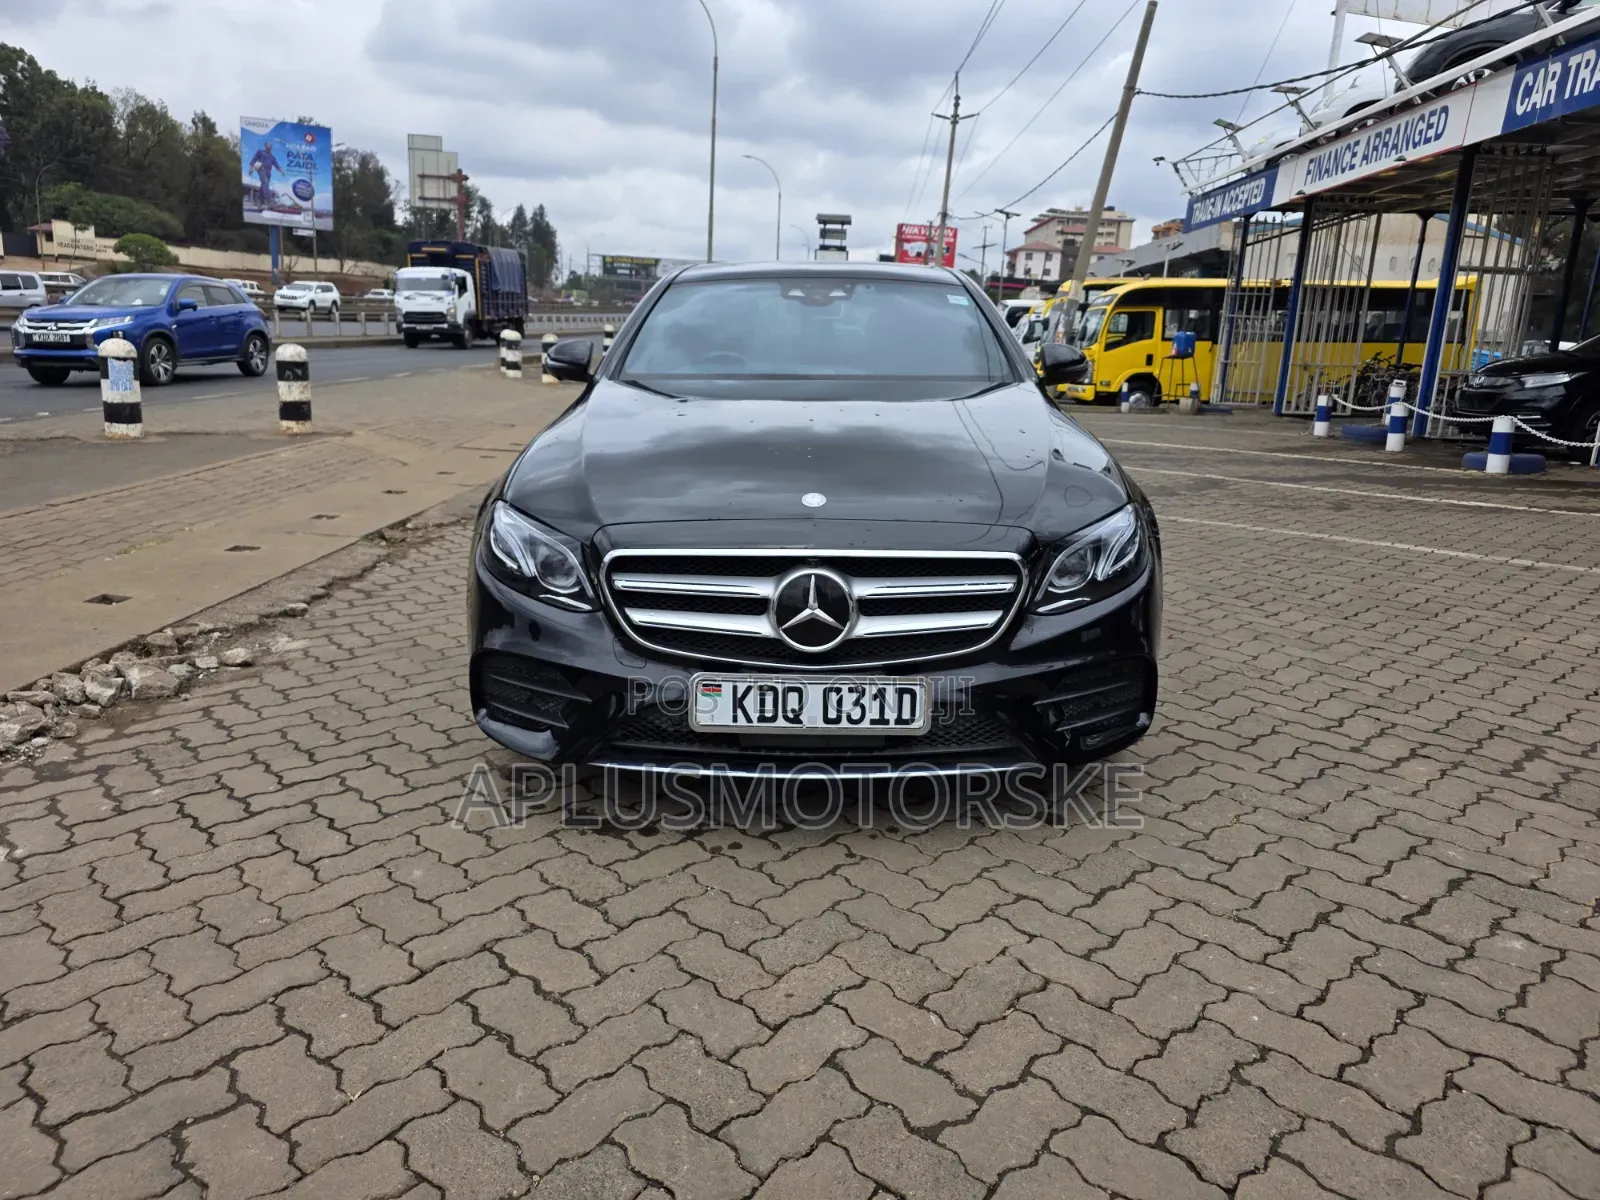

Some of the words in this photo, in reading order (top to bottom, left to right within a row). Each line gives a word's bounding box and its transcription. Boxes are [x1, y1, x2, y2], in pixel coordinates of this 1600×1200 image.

[1516, 61, 1562, 116] CAR
[1303, 138, 1361, 186] FINANCE
[1359, 104, 1449, 168] ARRANGED
[1191, 193, 1224, 225] TRADE-IN
[1220, 177, 1266, 216] ACCEPTED
[731, 684, 804, 725] KDQ
[822, 685, 918, 726] 031D
